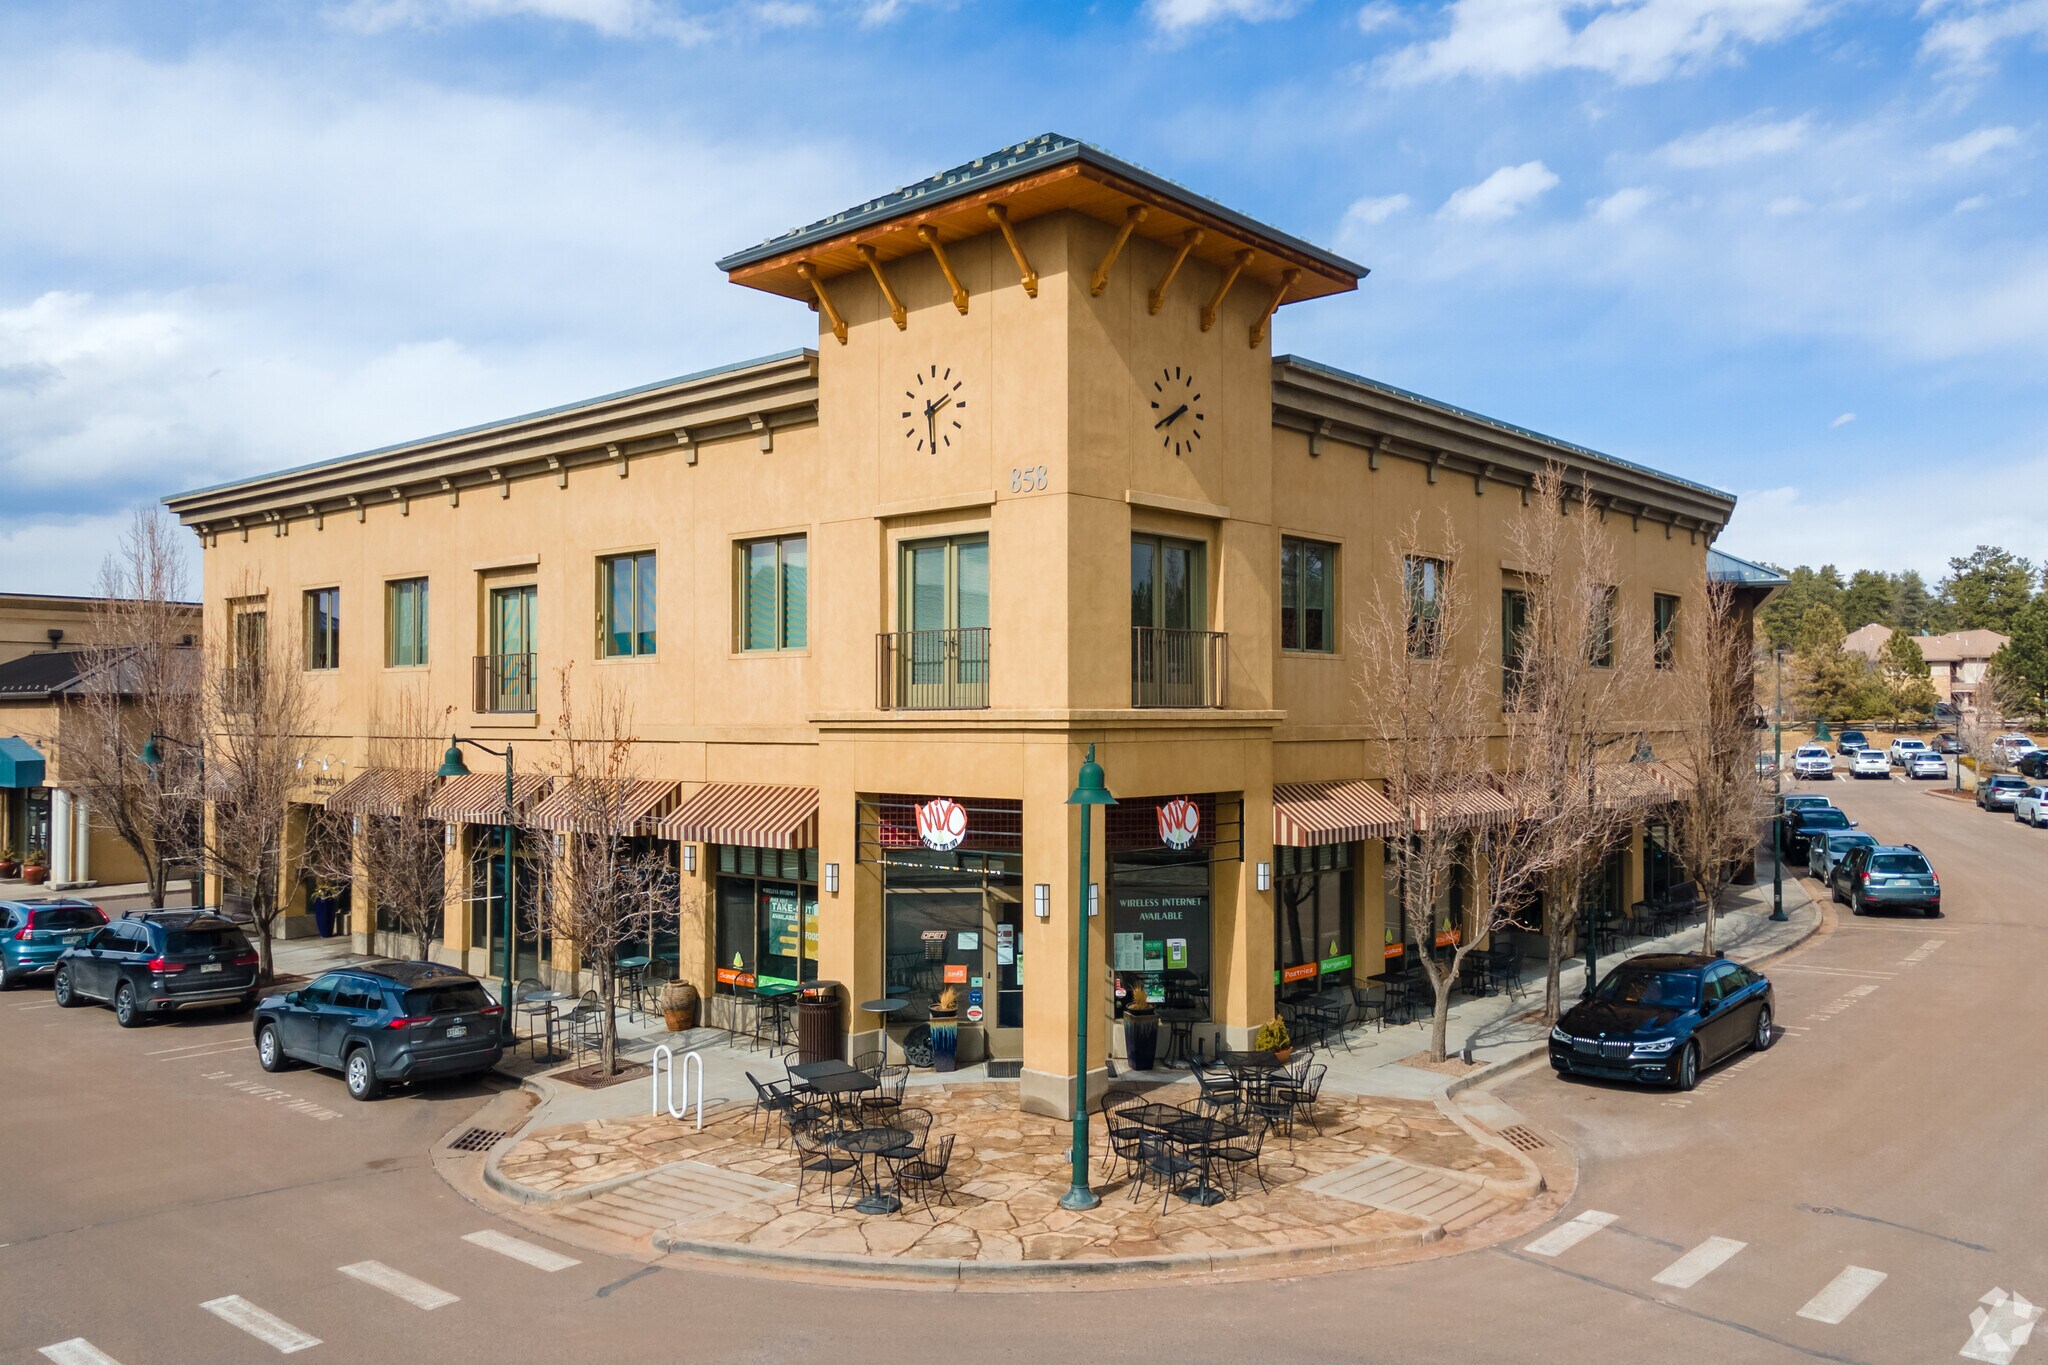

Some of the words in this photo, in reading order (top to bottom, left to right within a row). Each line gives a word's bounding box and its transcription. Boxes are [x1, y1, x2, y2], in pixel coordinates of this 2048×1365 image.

[1009, 465, 1048, 494] 858
[1119, 899, 1159, 908] WIRELESS
[1162, 898, 1202, 907] INTERNET
[1139, 912, 1184, 921] AVAILABLE
[922, 931, 947, 940] OPEN
[1284, 967, 1314, 979] Pastries
